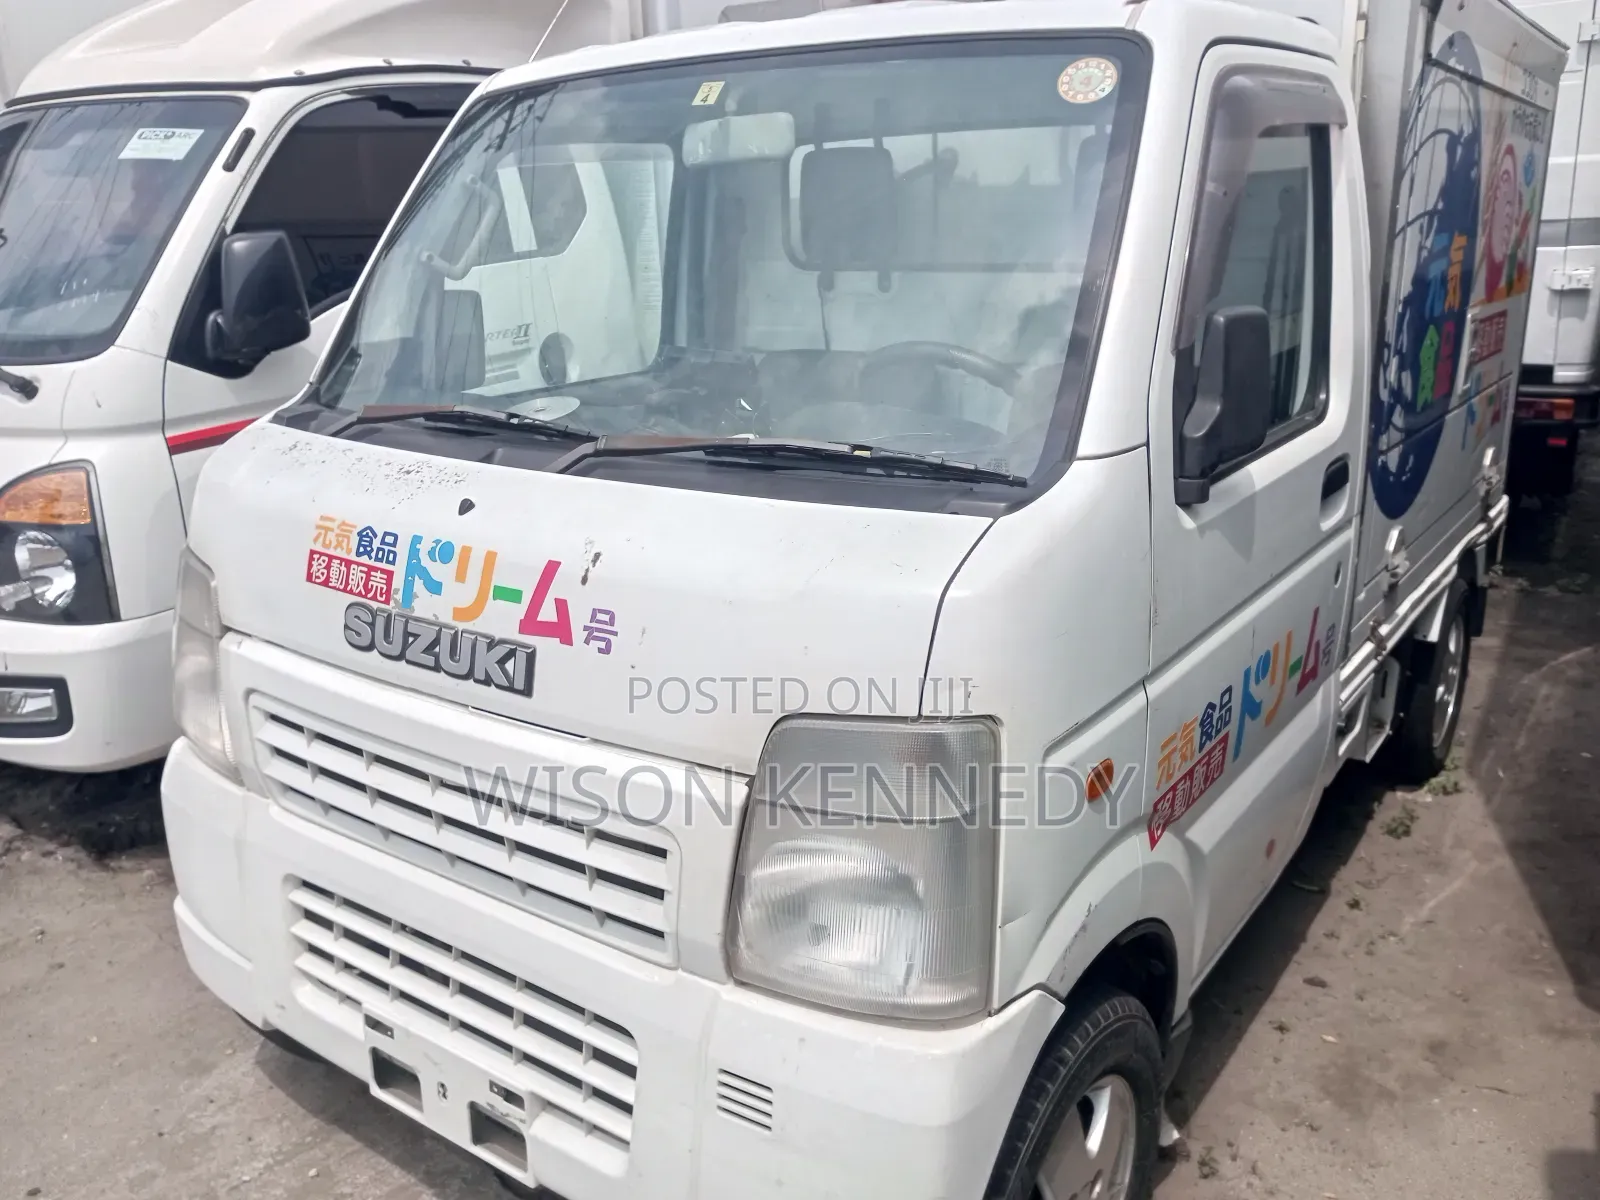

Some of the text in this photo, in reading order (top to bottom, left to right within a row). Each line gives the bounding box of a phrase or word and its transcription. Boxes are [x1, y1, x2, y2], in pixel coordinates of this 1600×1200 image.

[309, 553, 388, 602] 移動販売
[312, 515, 399, 566] 元気食品
[344, 601, 537, 700] SUZUKI
[1156, 684, 1233, 791] 元気食品
[1151, 738, 1226, 841] 移動販売
